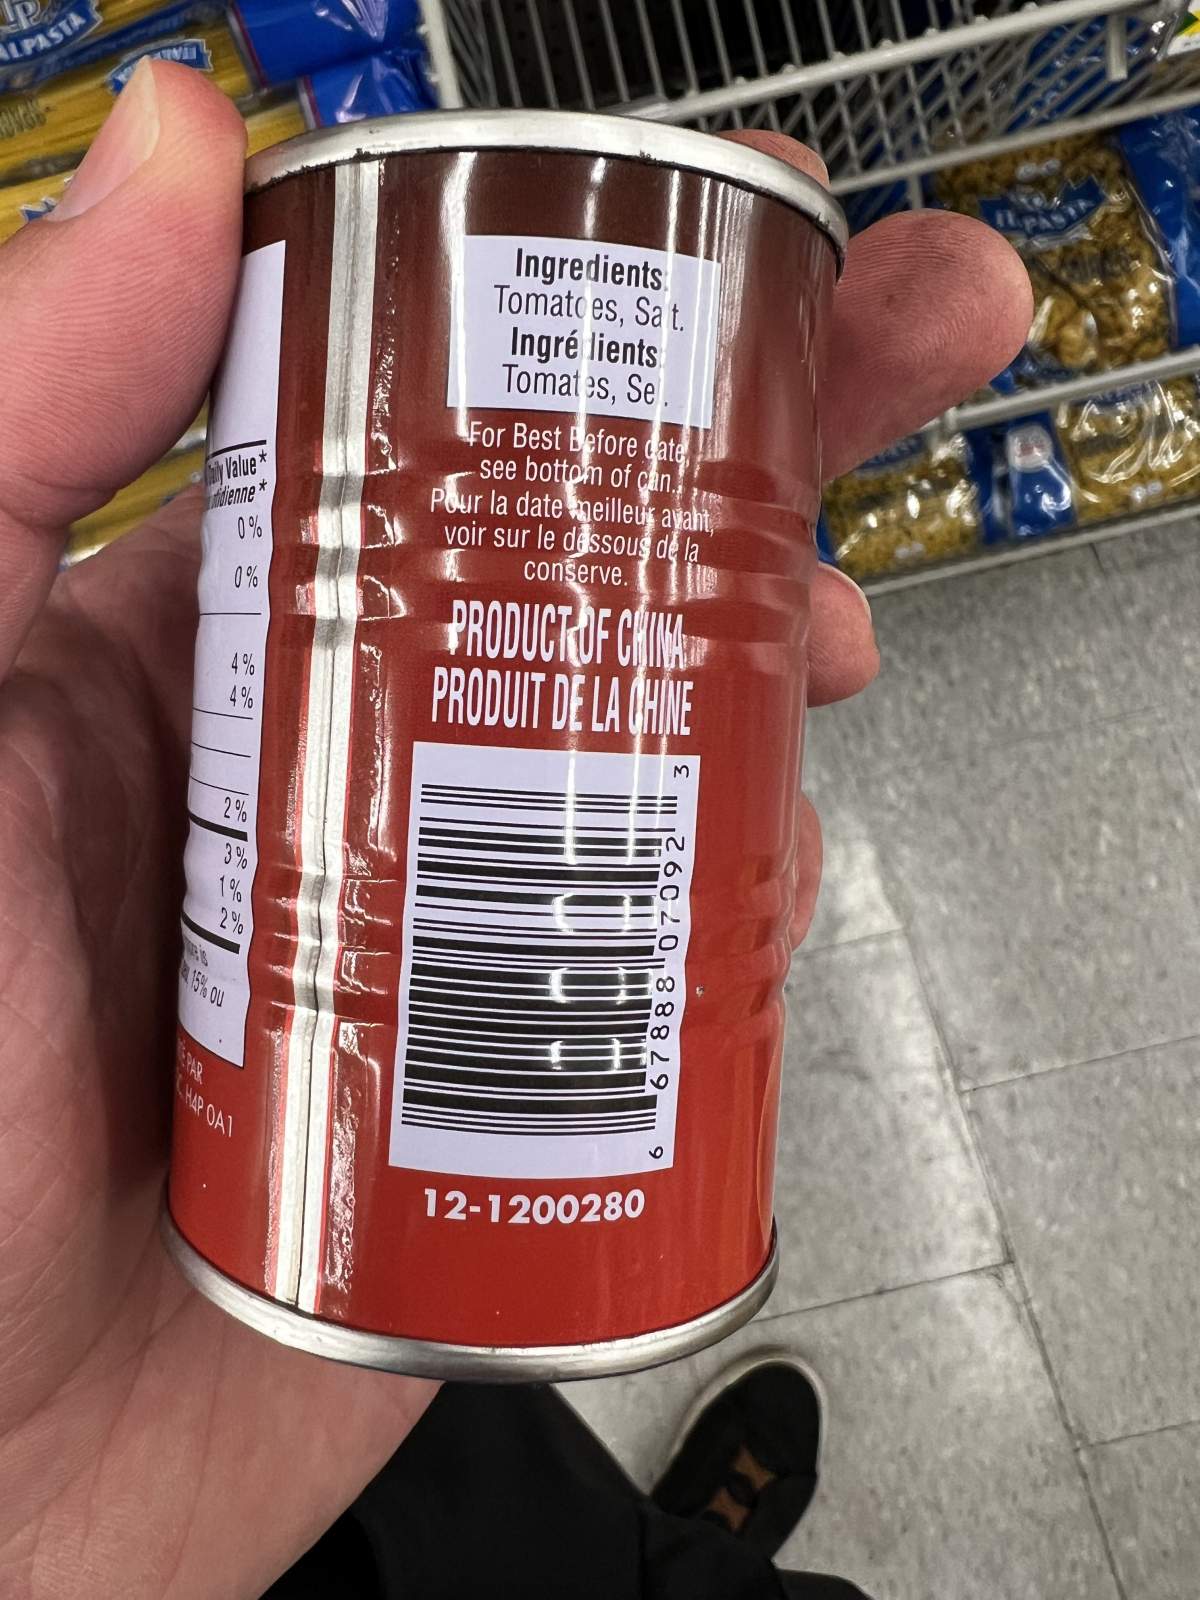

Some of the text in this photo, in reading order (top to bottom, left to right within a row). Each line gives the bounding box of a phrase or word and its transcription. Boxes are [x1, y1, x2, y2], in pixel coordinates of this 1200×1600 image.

[494, 284, 684, 332] Tomatoes, Sat.
[502, 364, 668, 407] Tomates, Se.
[468, 421, 506, 449] For
[513, 422, 562, 451] Best
[570, 424, 638, 458] Before
[480, 456, 672, 494] see bottom of can.
[431, 487, 714, 537] Pour la date meilleur avant,
[444, 525, 700, 563] voir sur le dessous de la
[524, 560, 629, 587] conserve.
[450, 599, 685, 669] PRODUCT OF CHINA
[431, 666, 694, 736] PRODUIT DE LA CHINE
[424, 1187, 645, 1225] 12-1200280
